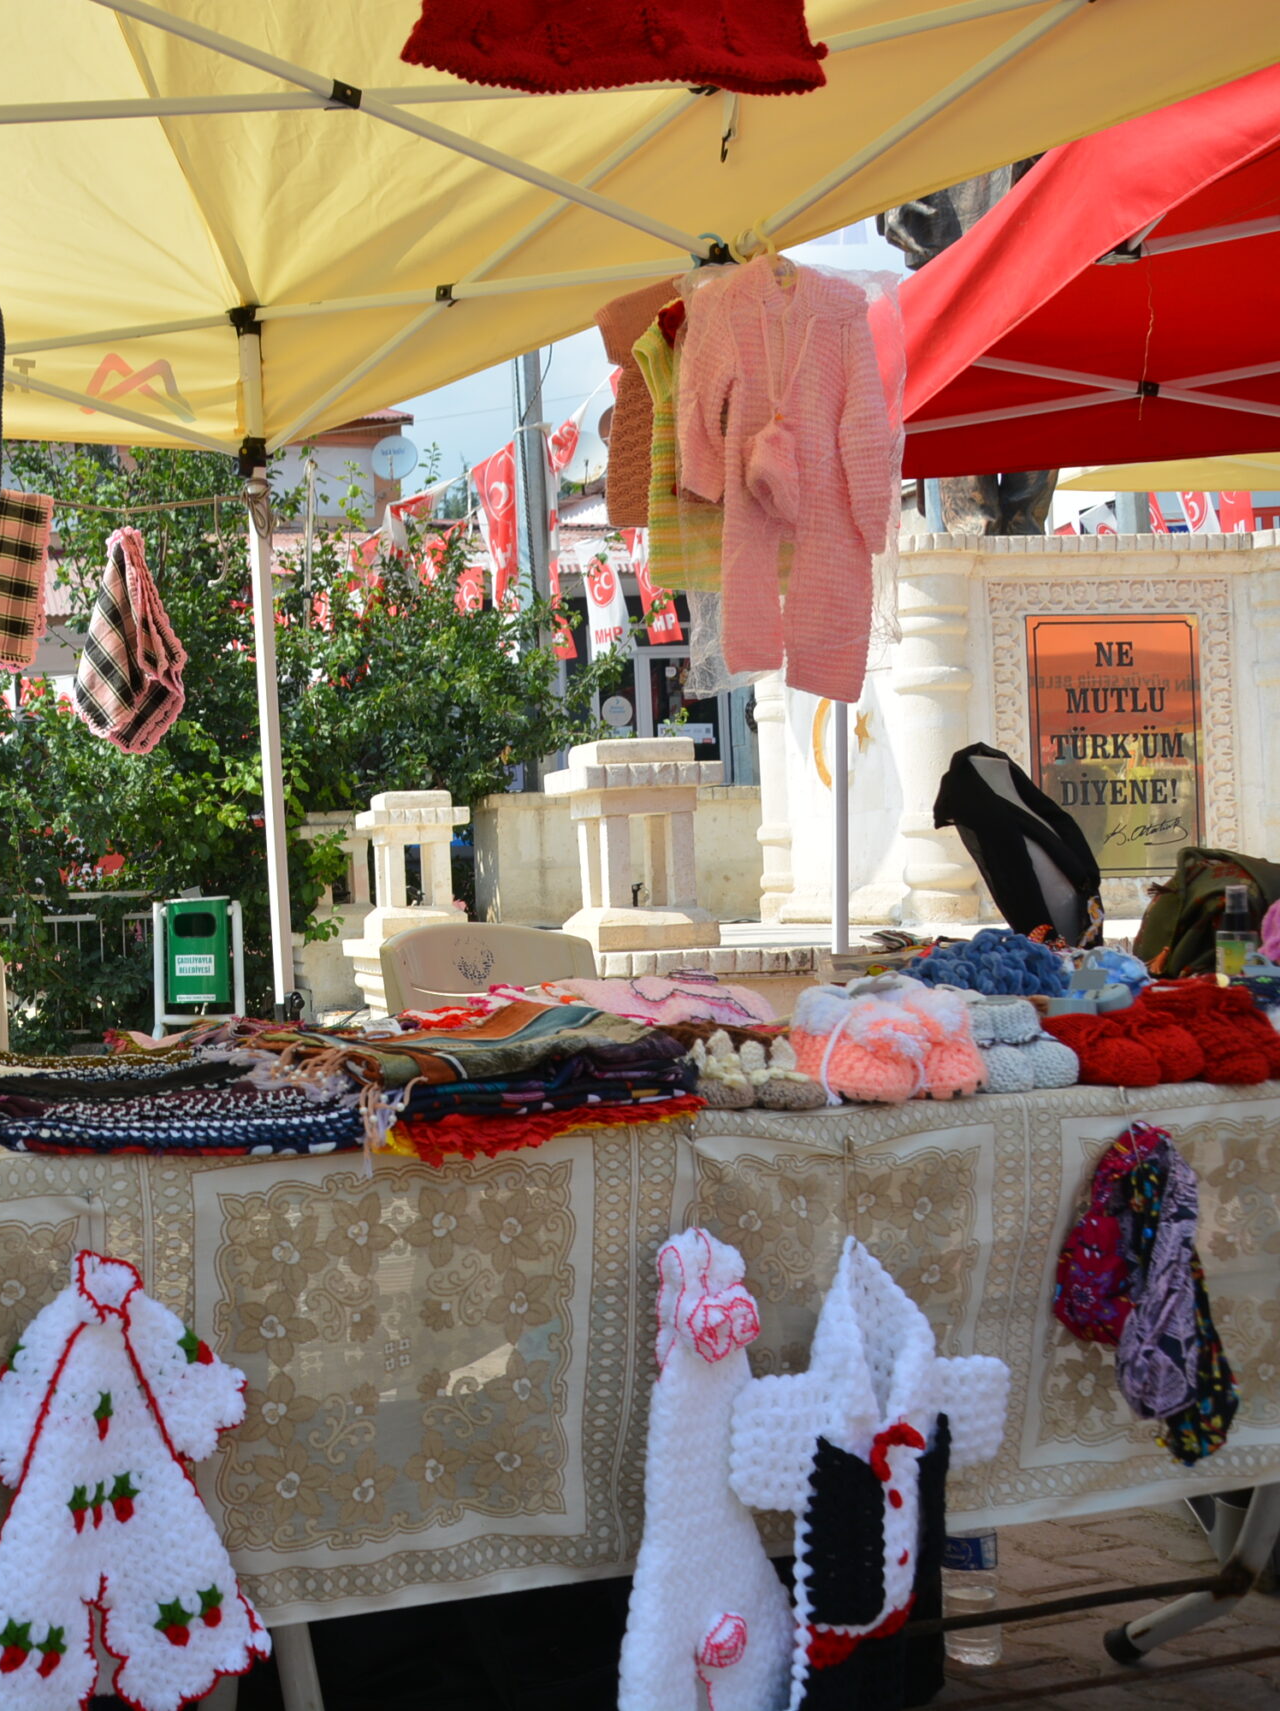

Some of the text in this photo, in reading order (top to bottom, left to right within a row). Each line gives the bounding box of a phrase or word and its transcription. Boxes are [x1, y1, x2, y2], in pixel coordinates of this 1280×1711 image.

[595, 625, 623, 644] MHP
[1094, 640, 1134, 668] NE
[1066, 686, 1166, 714] MUTLU
[1050, 725, 1185, 761] TÜRK'ÜM
[1060, 772, 1179, 806] DİYENE!
